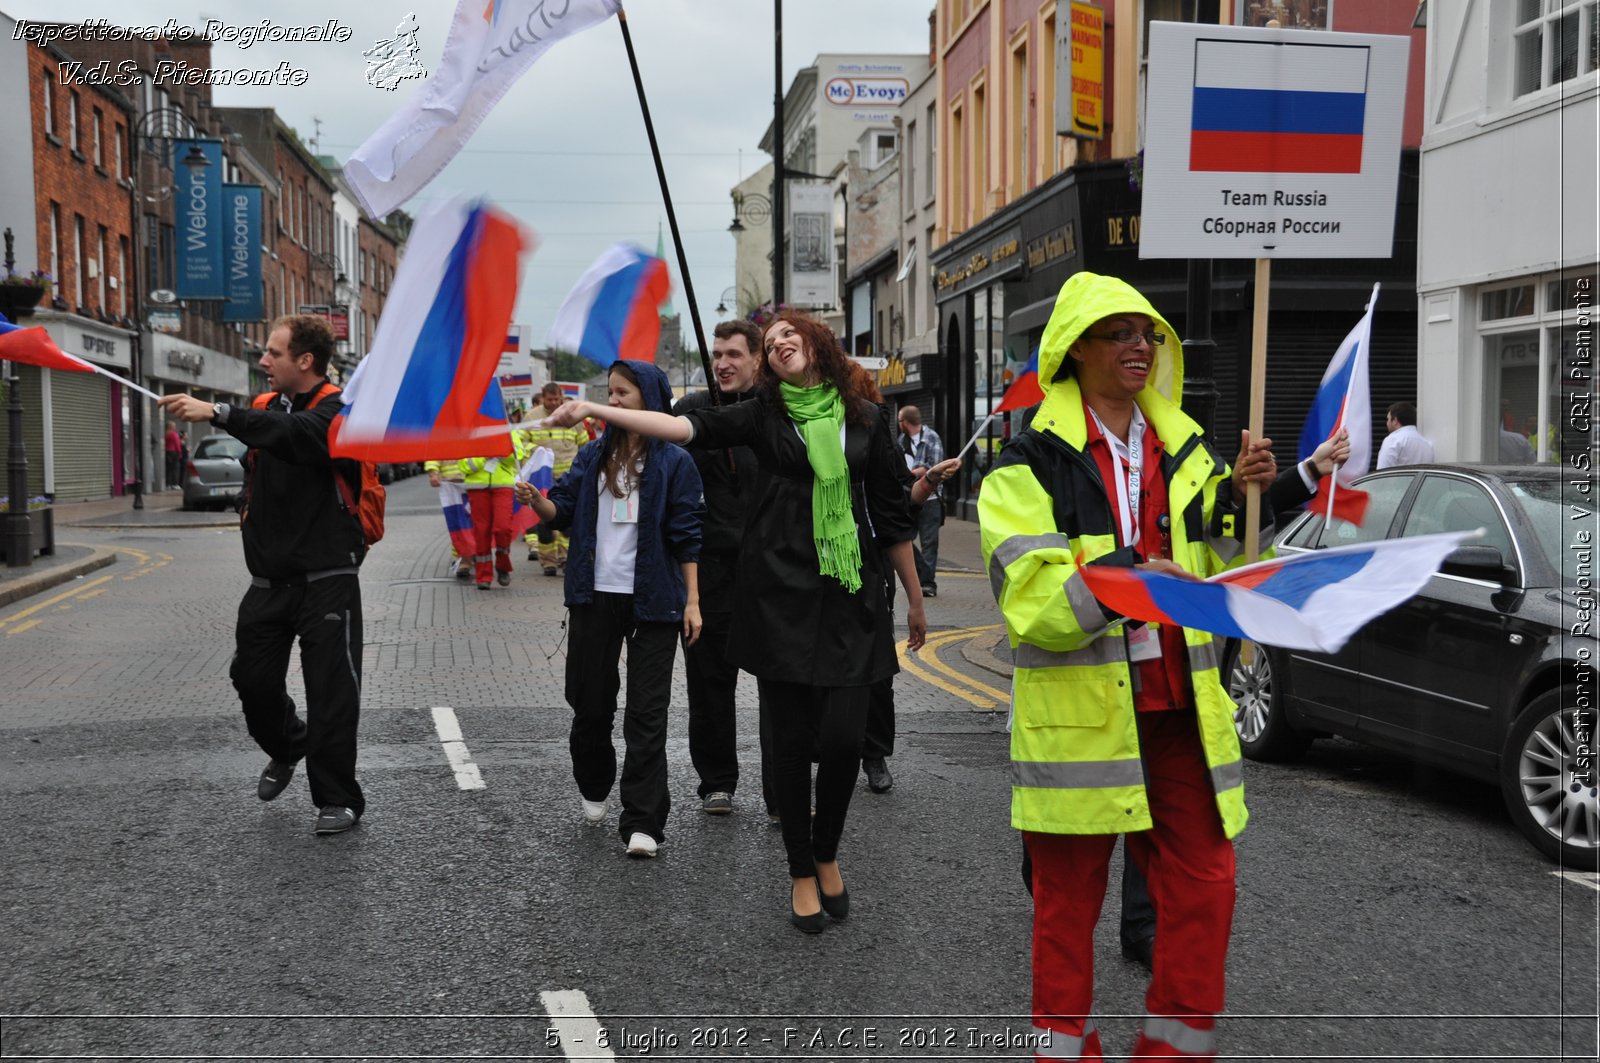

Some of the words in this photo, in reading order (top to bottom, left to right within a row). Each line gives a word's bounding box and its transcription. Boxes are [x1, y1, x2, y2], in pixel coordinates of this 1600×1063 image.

[187, 170, 207, 250] Welco
[1221, 189, 1267, 206] Team
[1273, 190, 1327, 207] Russia
[232, 195, 249, 280] Welcome
[1108, 217, 1123, 245] DE
[1129, 216, 1141, 244] O
[1202, 217, 1276, 238] Сборная
[1282, 218, 1341, 235] России
